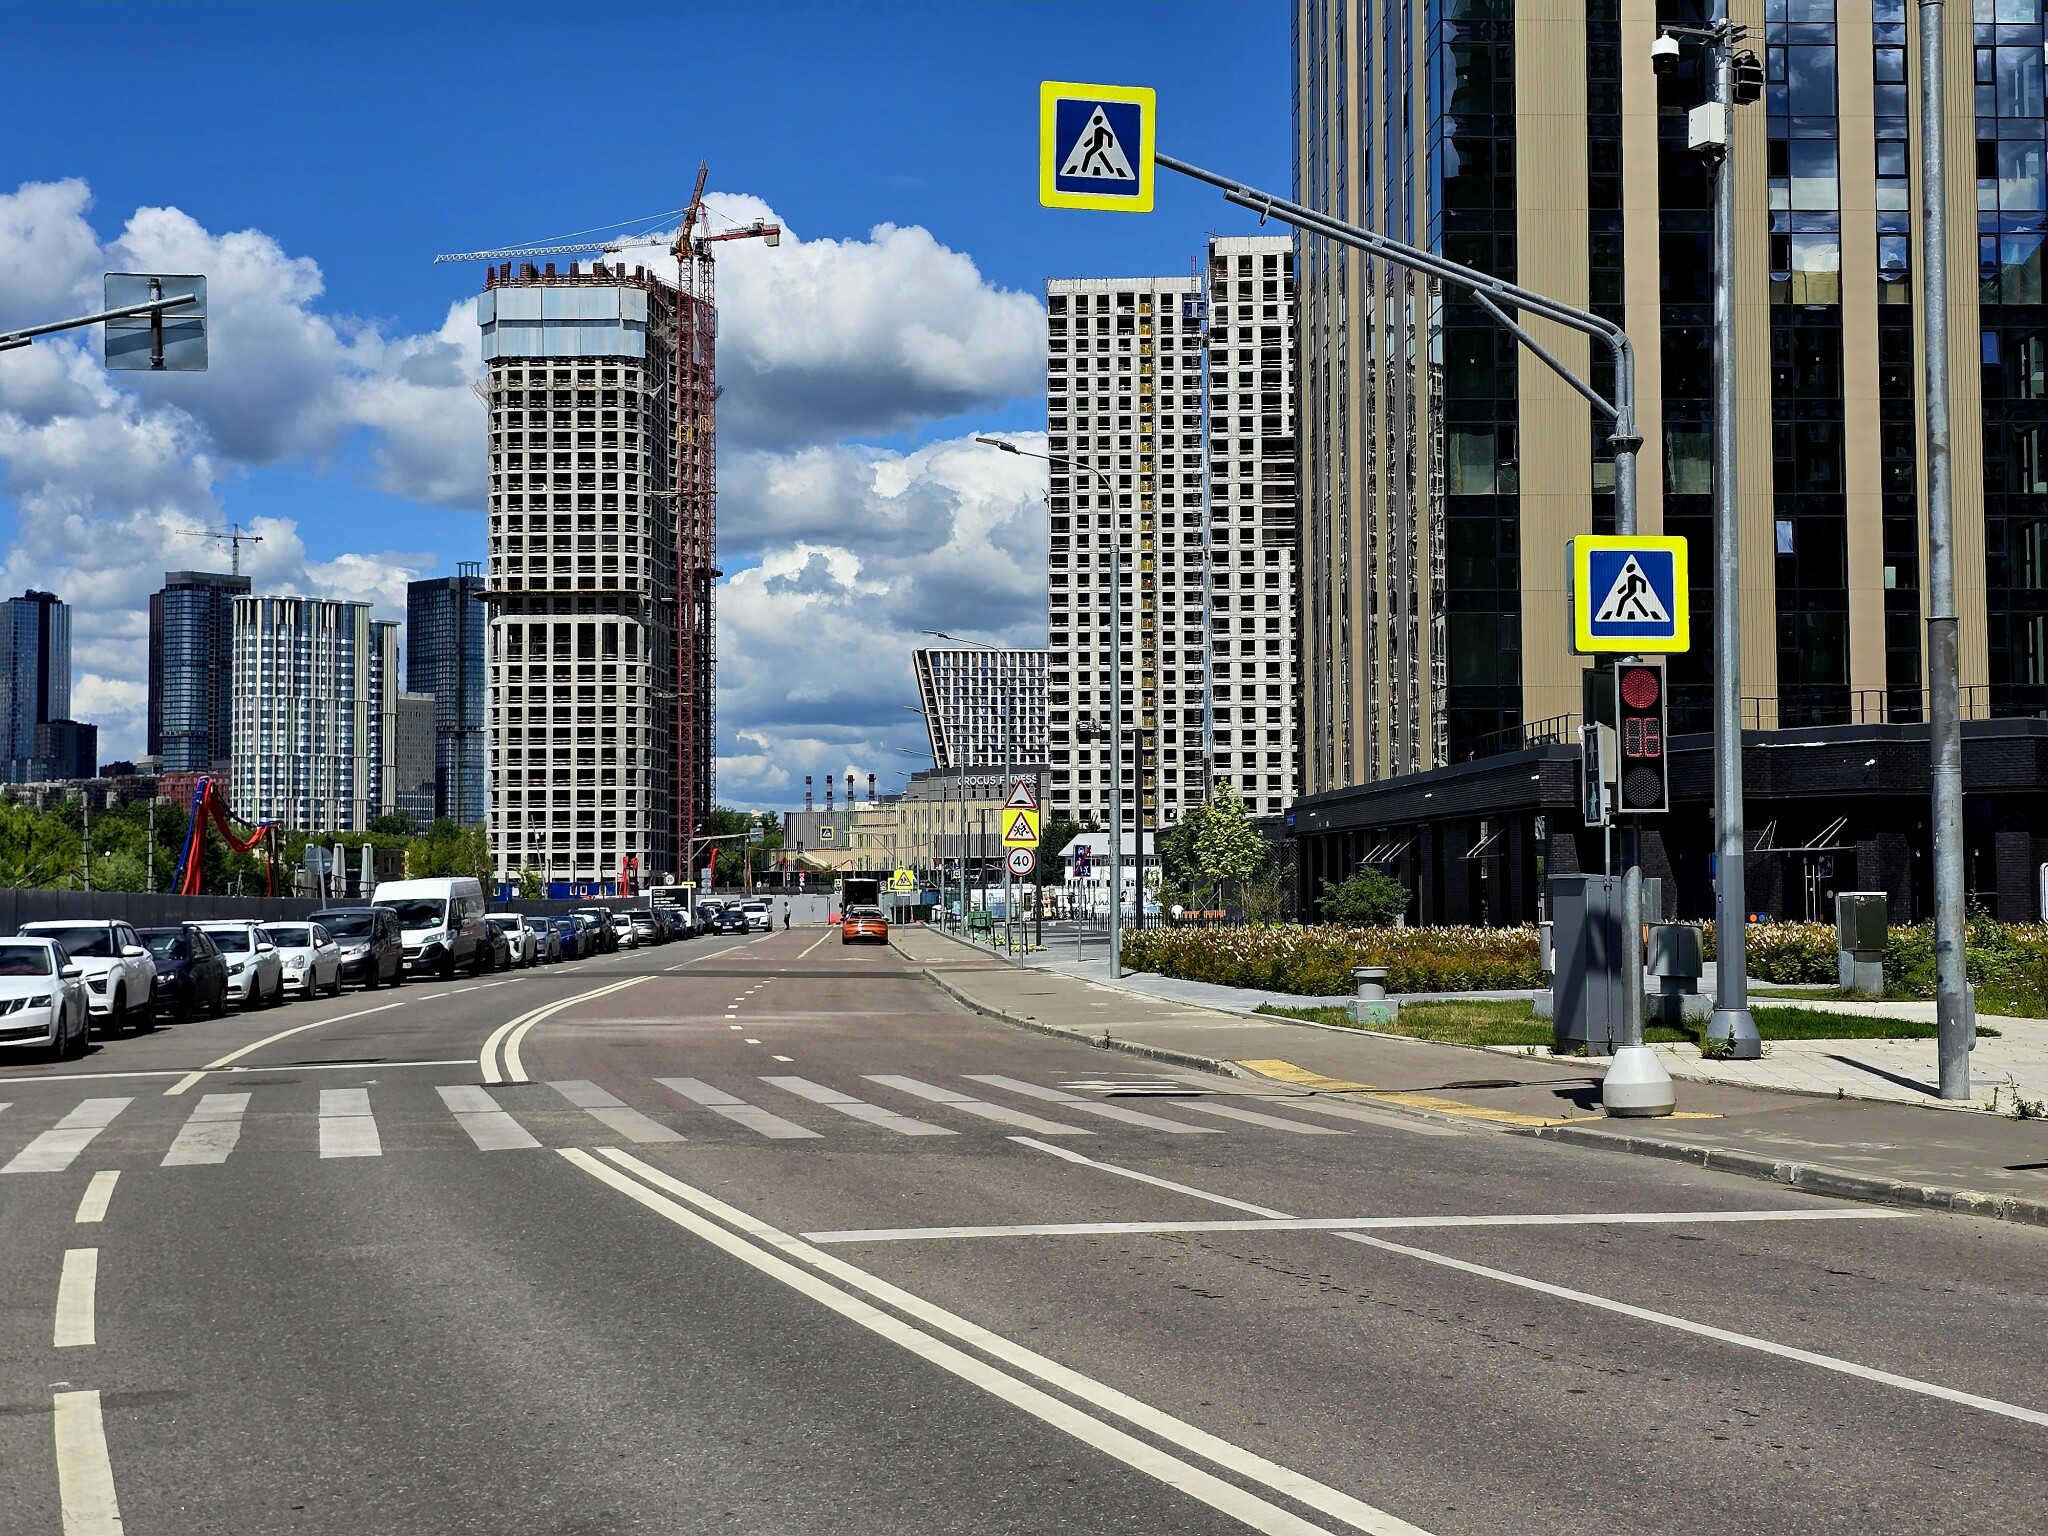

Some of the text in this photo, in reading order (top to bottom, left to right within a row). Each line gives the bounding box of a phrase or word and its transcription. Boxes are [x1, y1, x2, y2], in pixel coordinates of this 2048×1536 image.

[957, 774, 1037, 786] CROCUS FTNESS
[1013, 855, 1029, 867] 40
